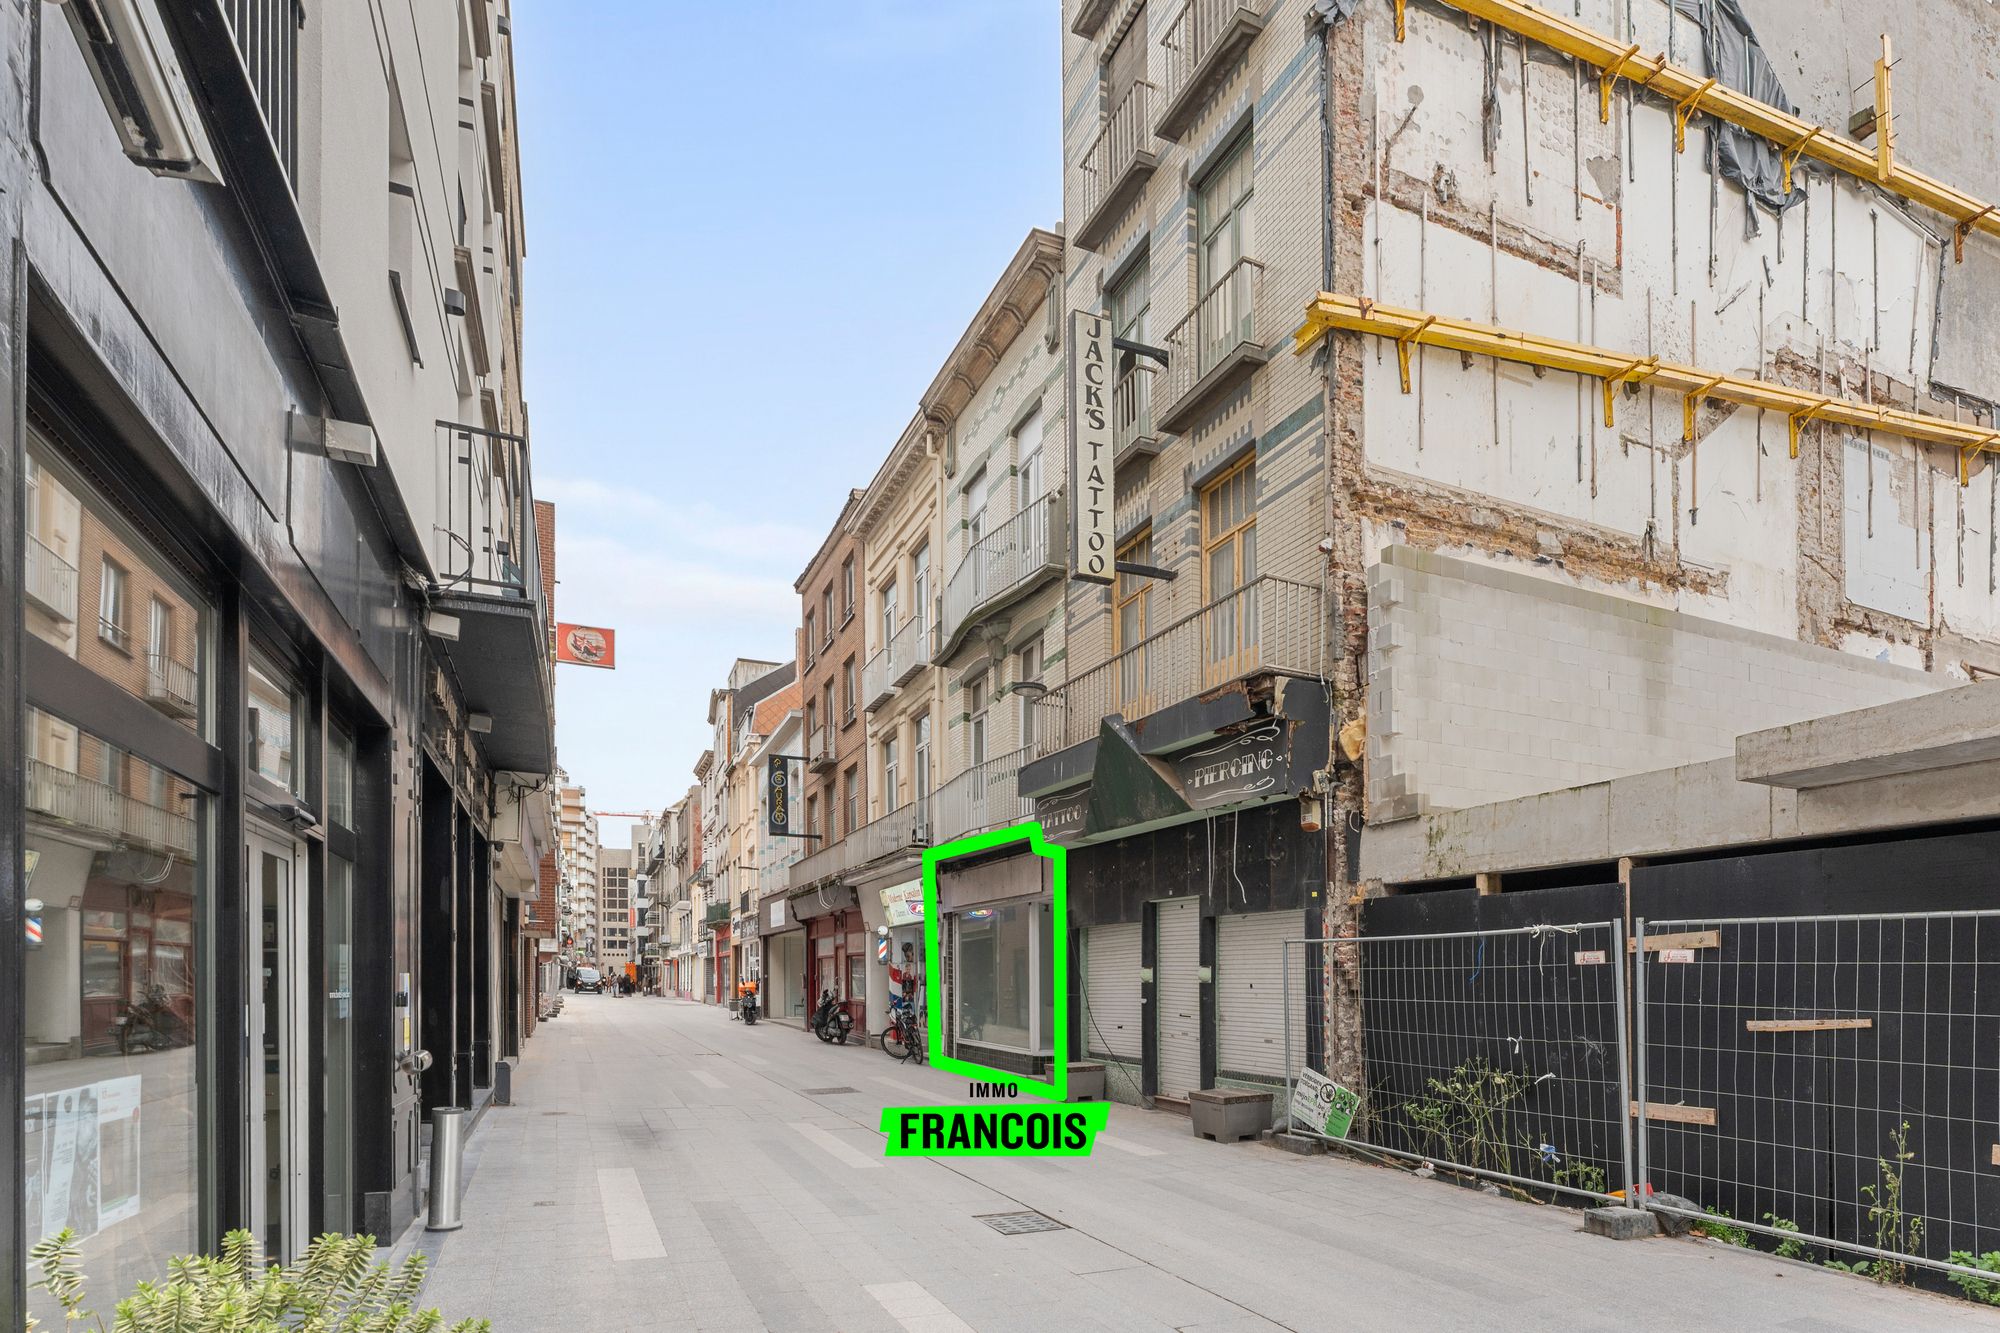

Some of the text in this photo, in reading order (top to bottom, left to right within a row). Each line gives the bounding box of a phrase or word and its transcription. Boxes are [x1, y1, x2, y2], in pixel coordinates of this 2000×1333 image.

[1085, 318, 1105, 574] JACK'S TATTOO
[1194, 749, 1273, 788] PIERCING
[1040, 804, 1082, 830] TATTOO
